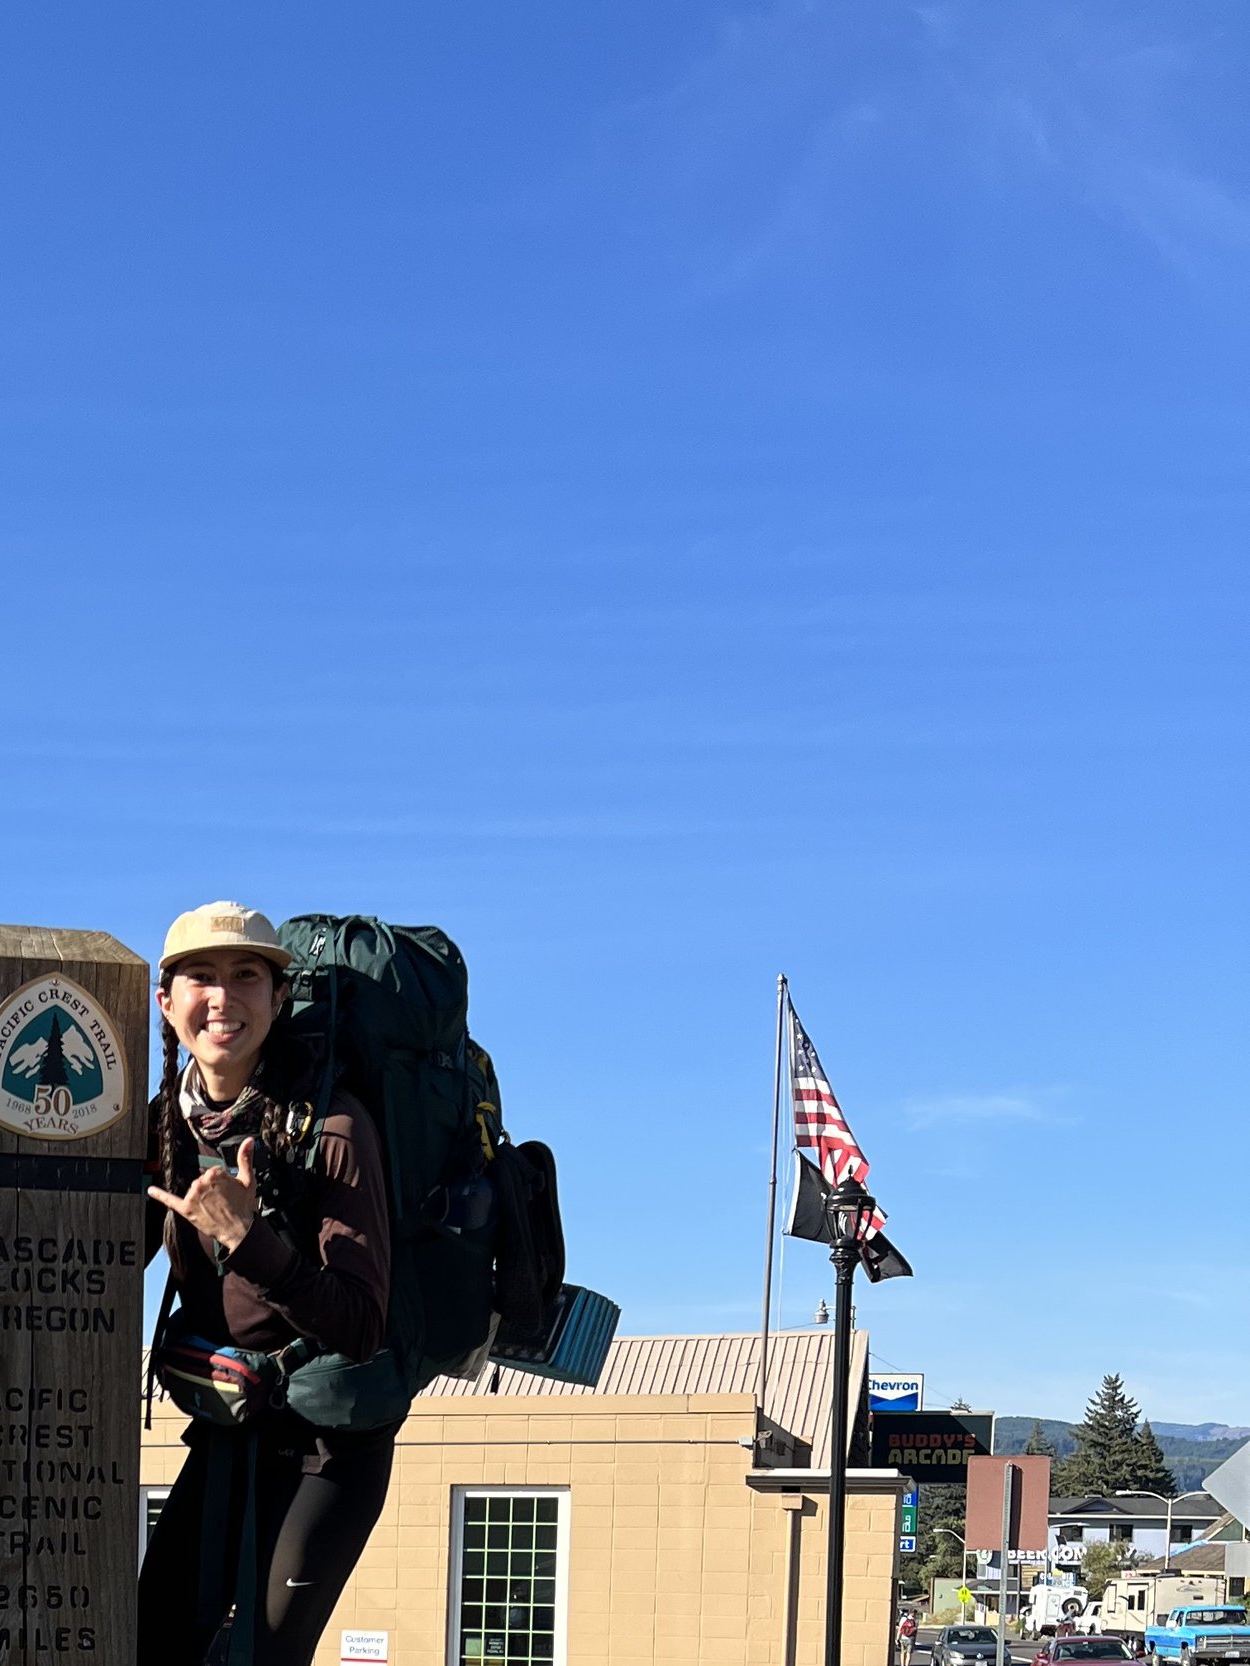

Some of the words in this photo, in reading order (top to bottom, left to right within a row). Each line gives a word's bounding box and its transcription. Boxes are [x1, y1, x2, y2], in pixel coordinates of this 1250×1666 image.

[38, 988, 89, 1018] CREST
[90, 1019, 117, 1071] TRAIL
[5, 1097, 32, 1115] 1968
[34, 1086, 72, 1117] 50
[72, 1104, 98, 1119] 2018
[23, 1116, 79, 1136] YEARS
[889, 1433, 976, 1448] BUDDY'S
[888, 1449, 976, 1465] ARCADE
[1007, 1550, 1048, 1560] BEER
[345, 1635, 385, 1645] Customer
[349, 1646, 380, 1656] Parking
